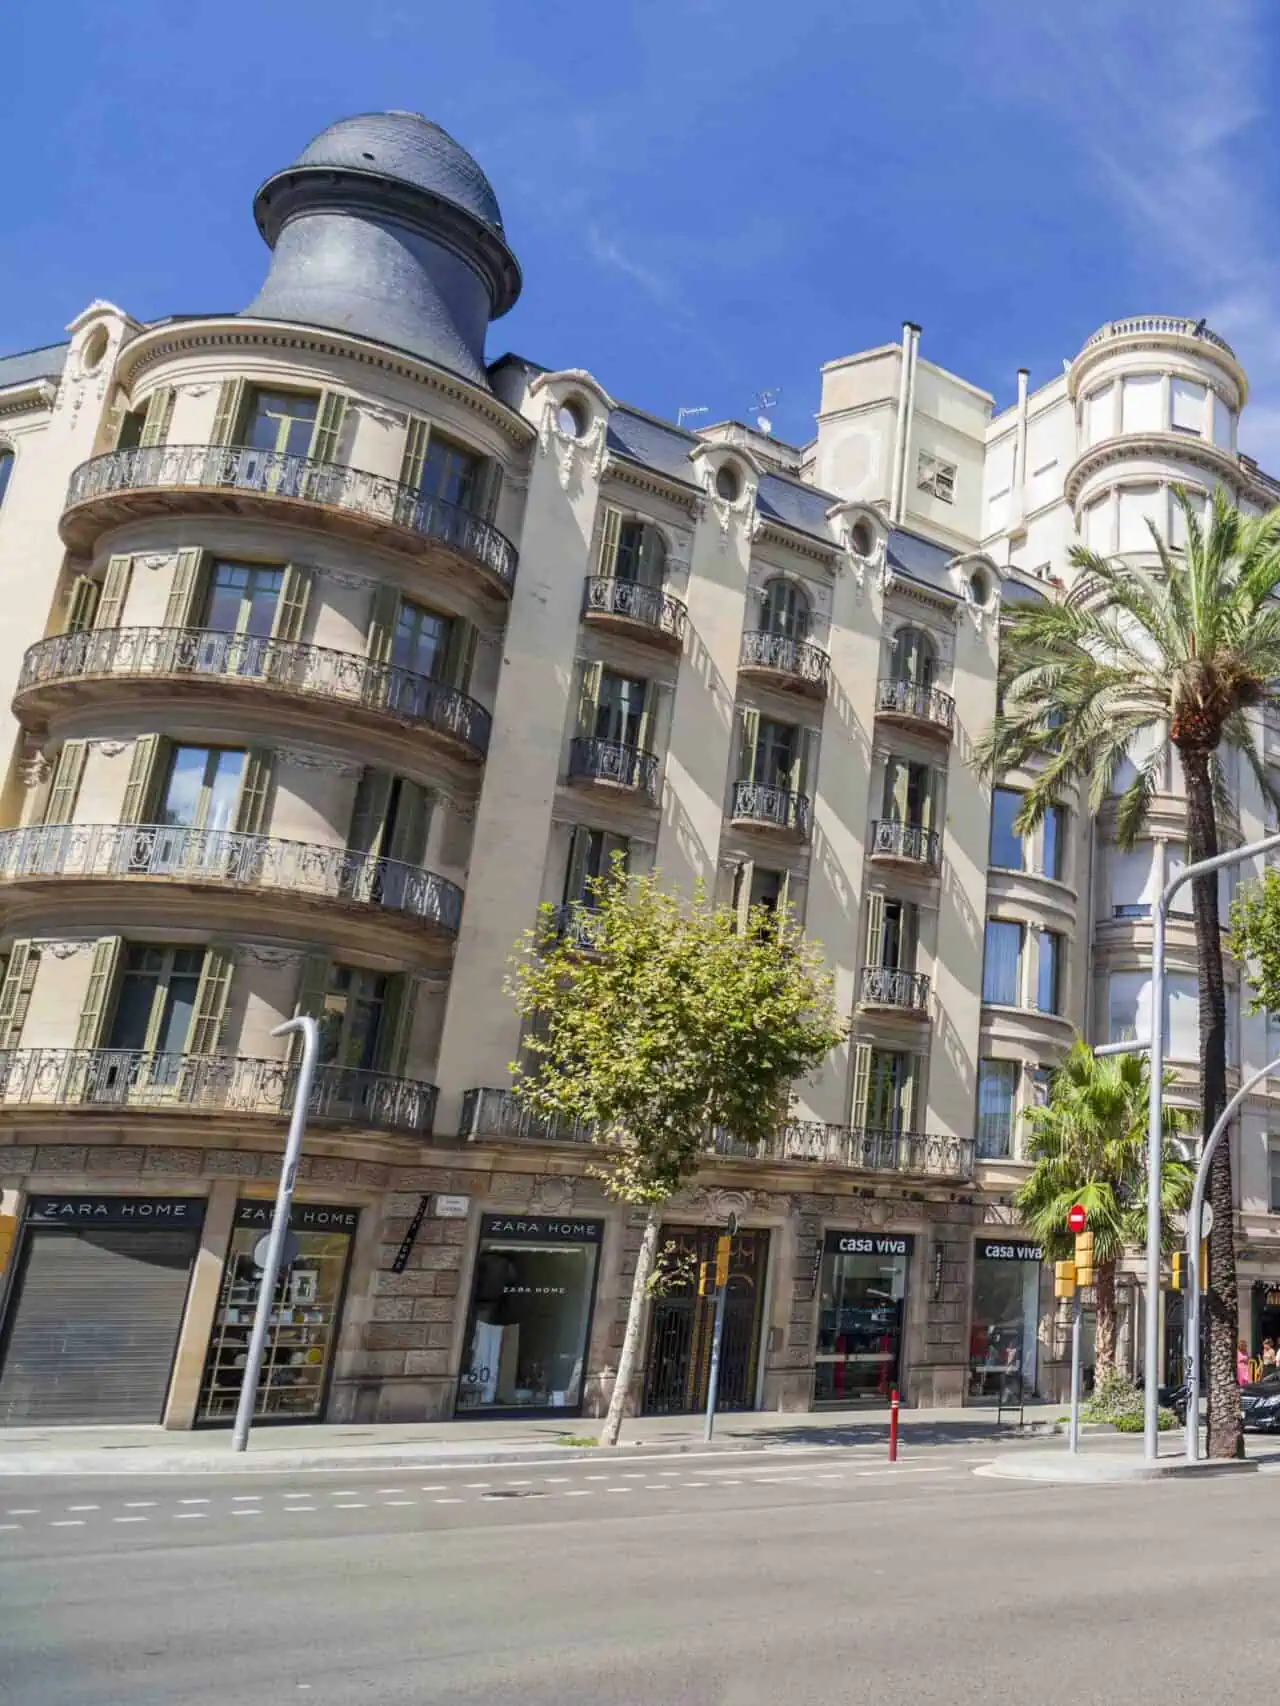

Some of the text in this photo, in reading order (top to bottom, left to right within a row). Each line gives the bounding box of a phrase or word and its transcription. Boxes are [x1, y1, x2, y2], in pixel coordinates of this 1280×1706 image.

[45, 1203, 187, 1216] ZARA HOME
[303, 1211, 356, 1225] HOME
[491, 1221, 596, 1235] ZARA HOME
[840, 1239, 905, 1253] casa viva
[985, 1245, 1043, 1259] casa viva
